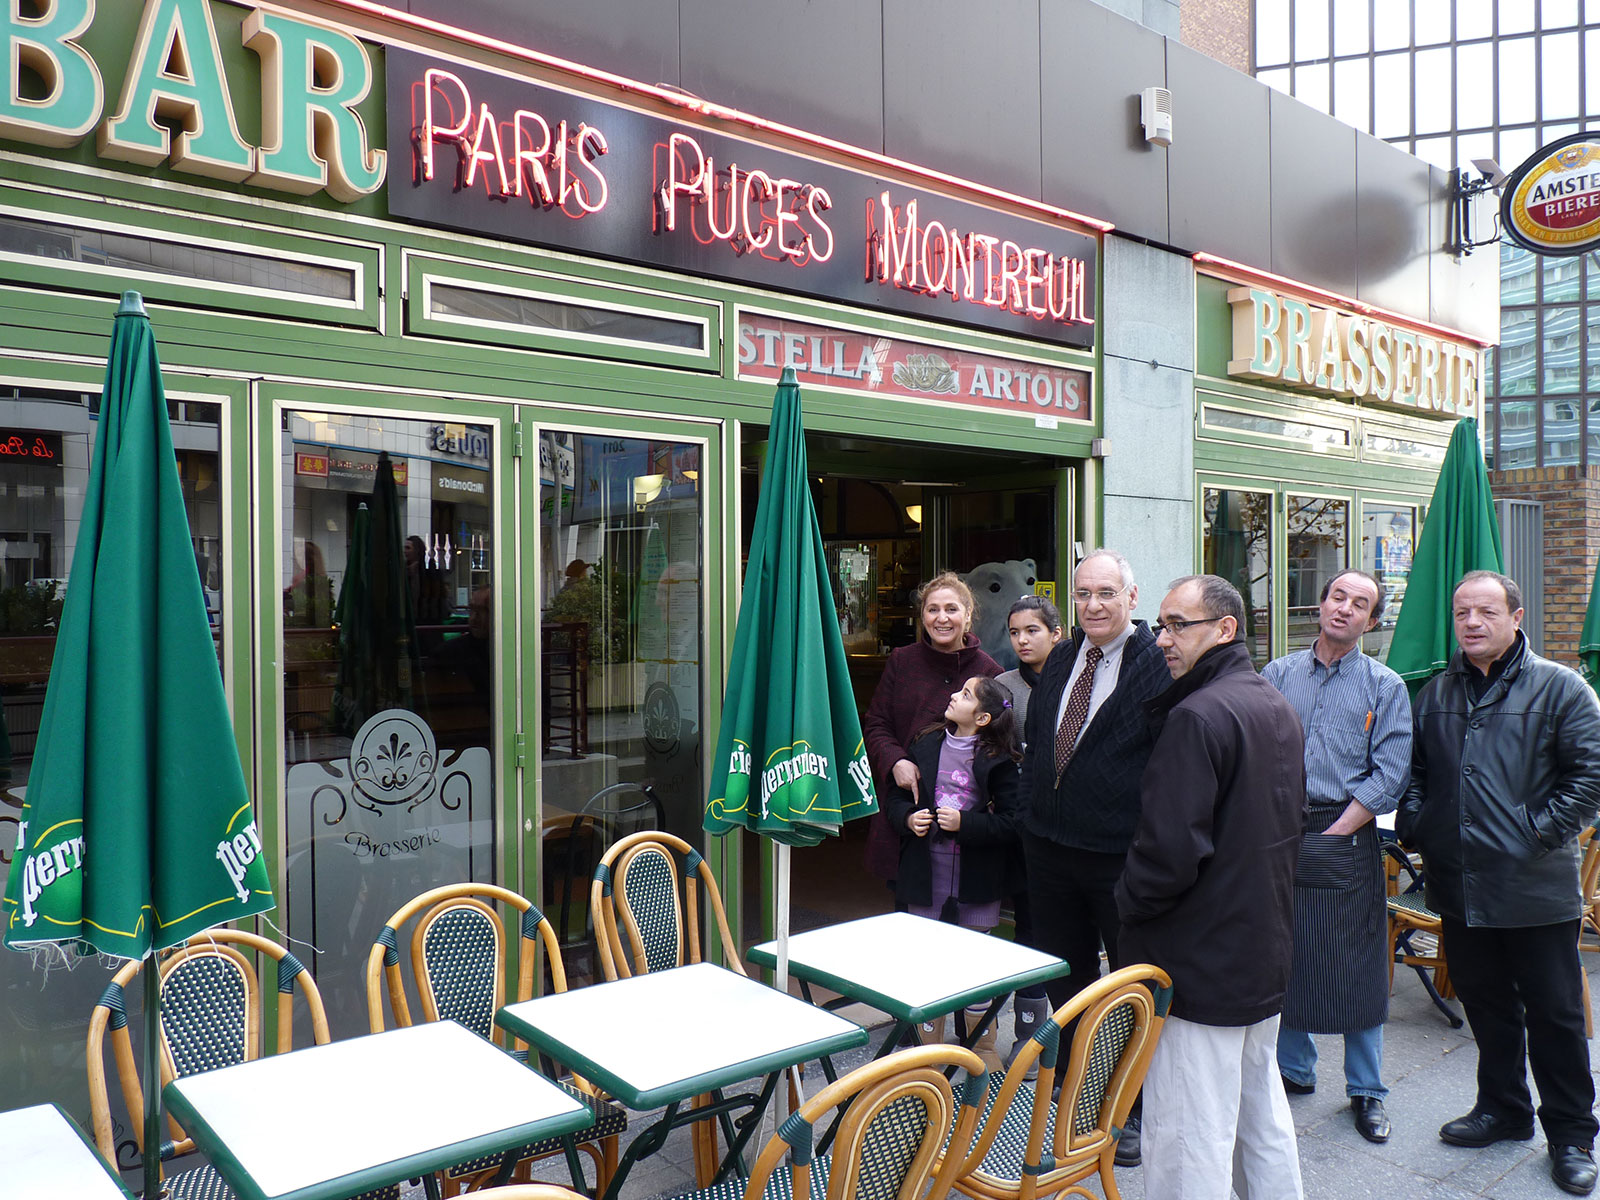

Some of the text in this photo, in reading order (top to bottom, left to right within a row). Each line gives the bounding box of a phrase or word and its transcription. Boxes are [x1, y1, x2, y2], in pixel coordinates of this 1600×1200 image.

[0, 0, 388, 203] BAR
[424, 67, 1096, 326] PARIS PUCES MONTREUIL
[1544, 193, 1600, 217] BIERE
[739, 322, 1081, 411] STELLA ARTOIS
[1248, 288, 1479, 418] BRASSERIE
[344, 826, 442, 858] Brasserie
